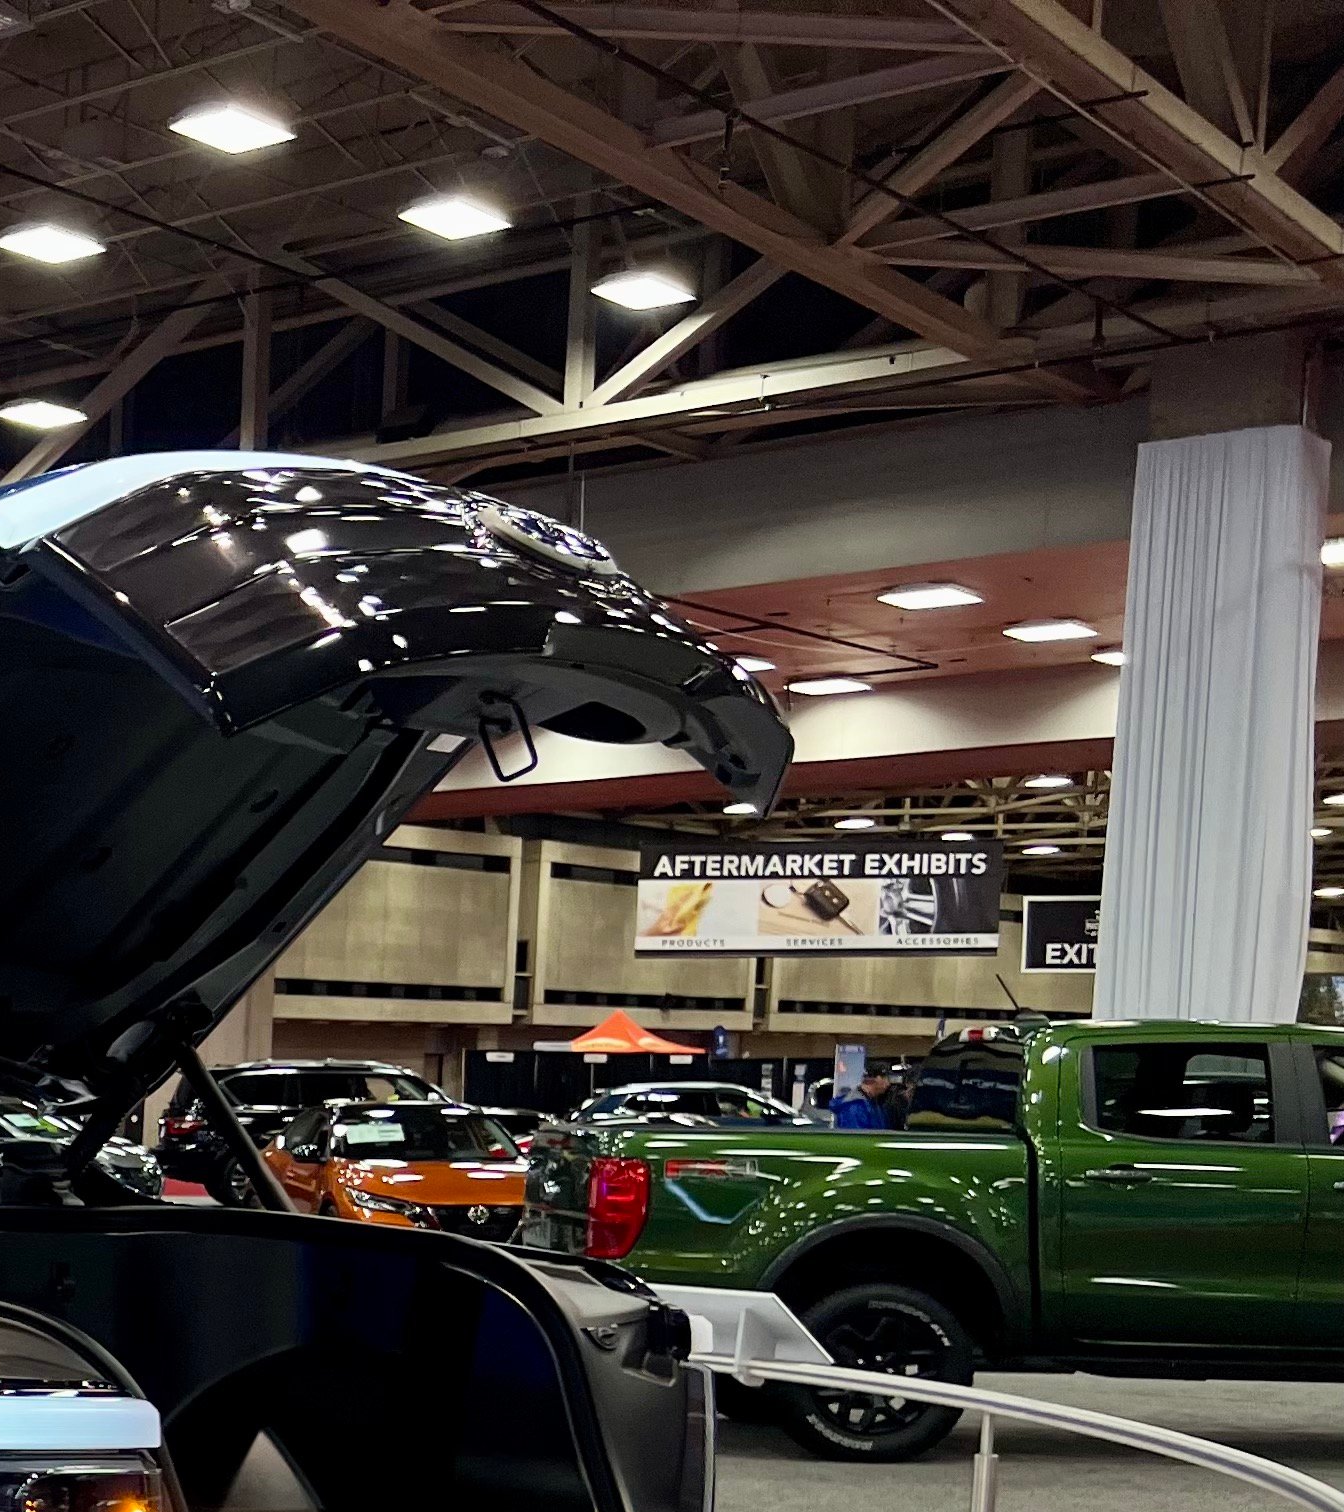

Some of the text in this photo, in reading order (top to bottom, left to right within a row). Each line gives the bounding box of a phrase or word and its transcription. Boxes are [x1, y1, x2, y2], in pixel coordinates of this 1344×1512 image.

[653, 852, 988, 878] AFTERMARKET EXHIBITS
[661, 938, 726, 948] PRODUCTS
[785, 938, 844, 947] SERVICES
[896, 936, 980, 946] ACCESSORIES
